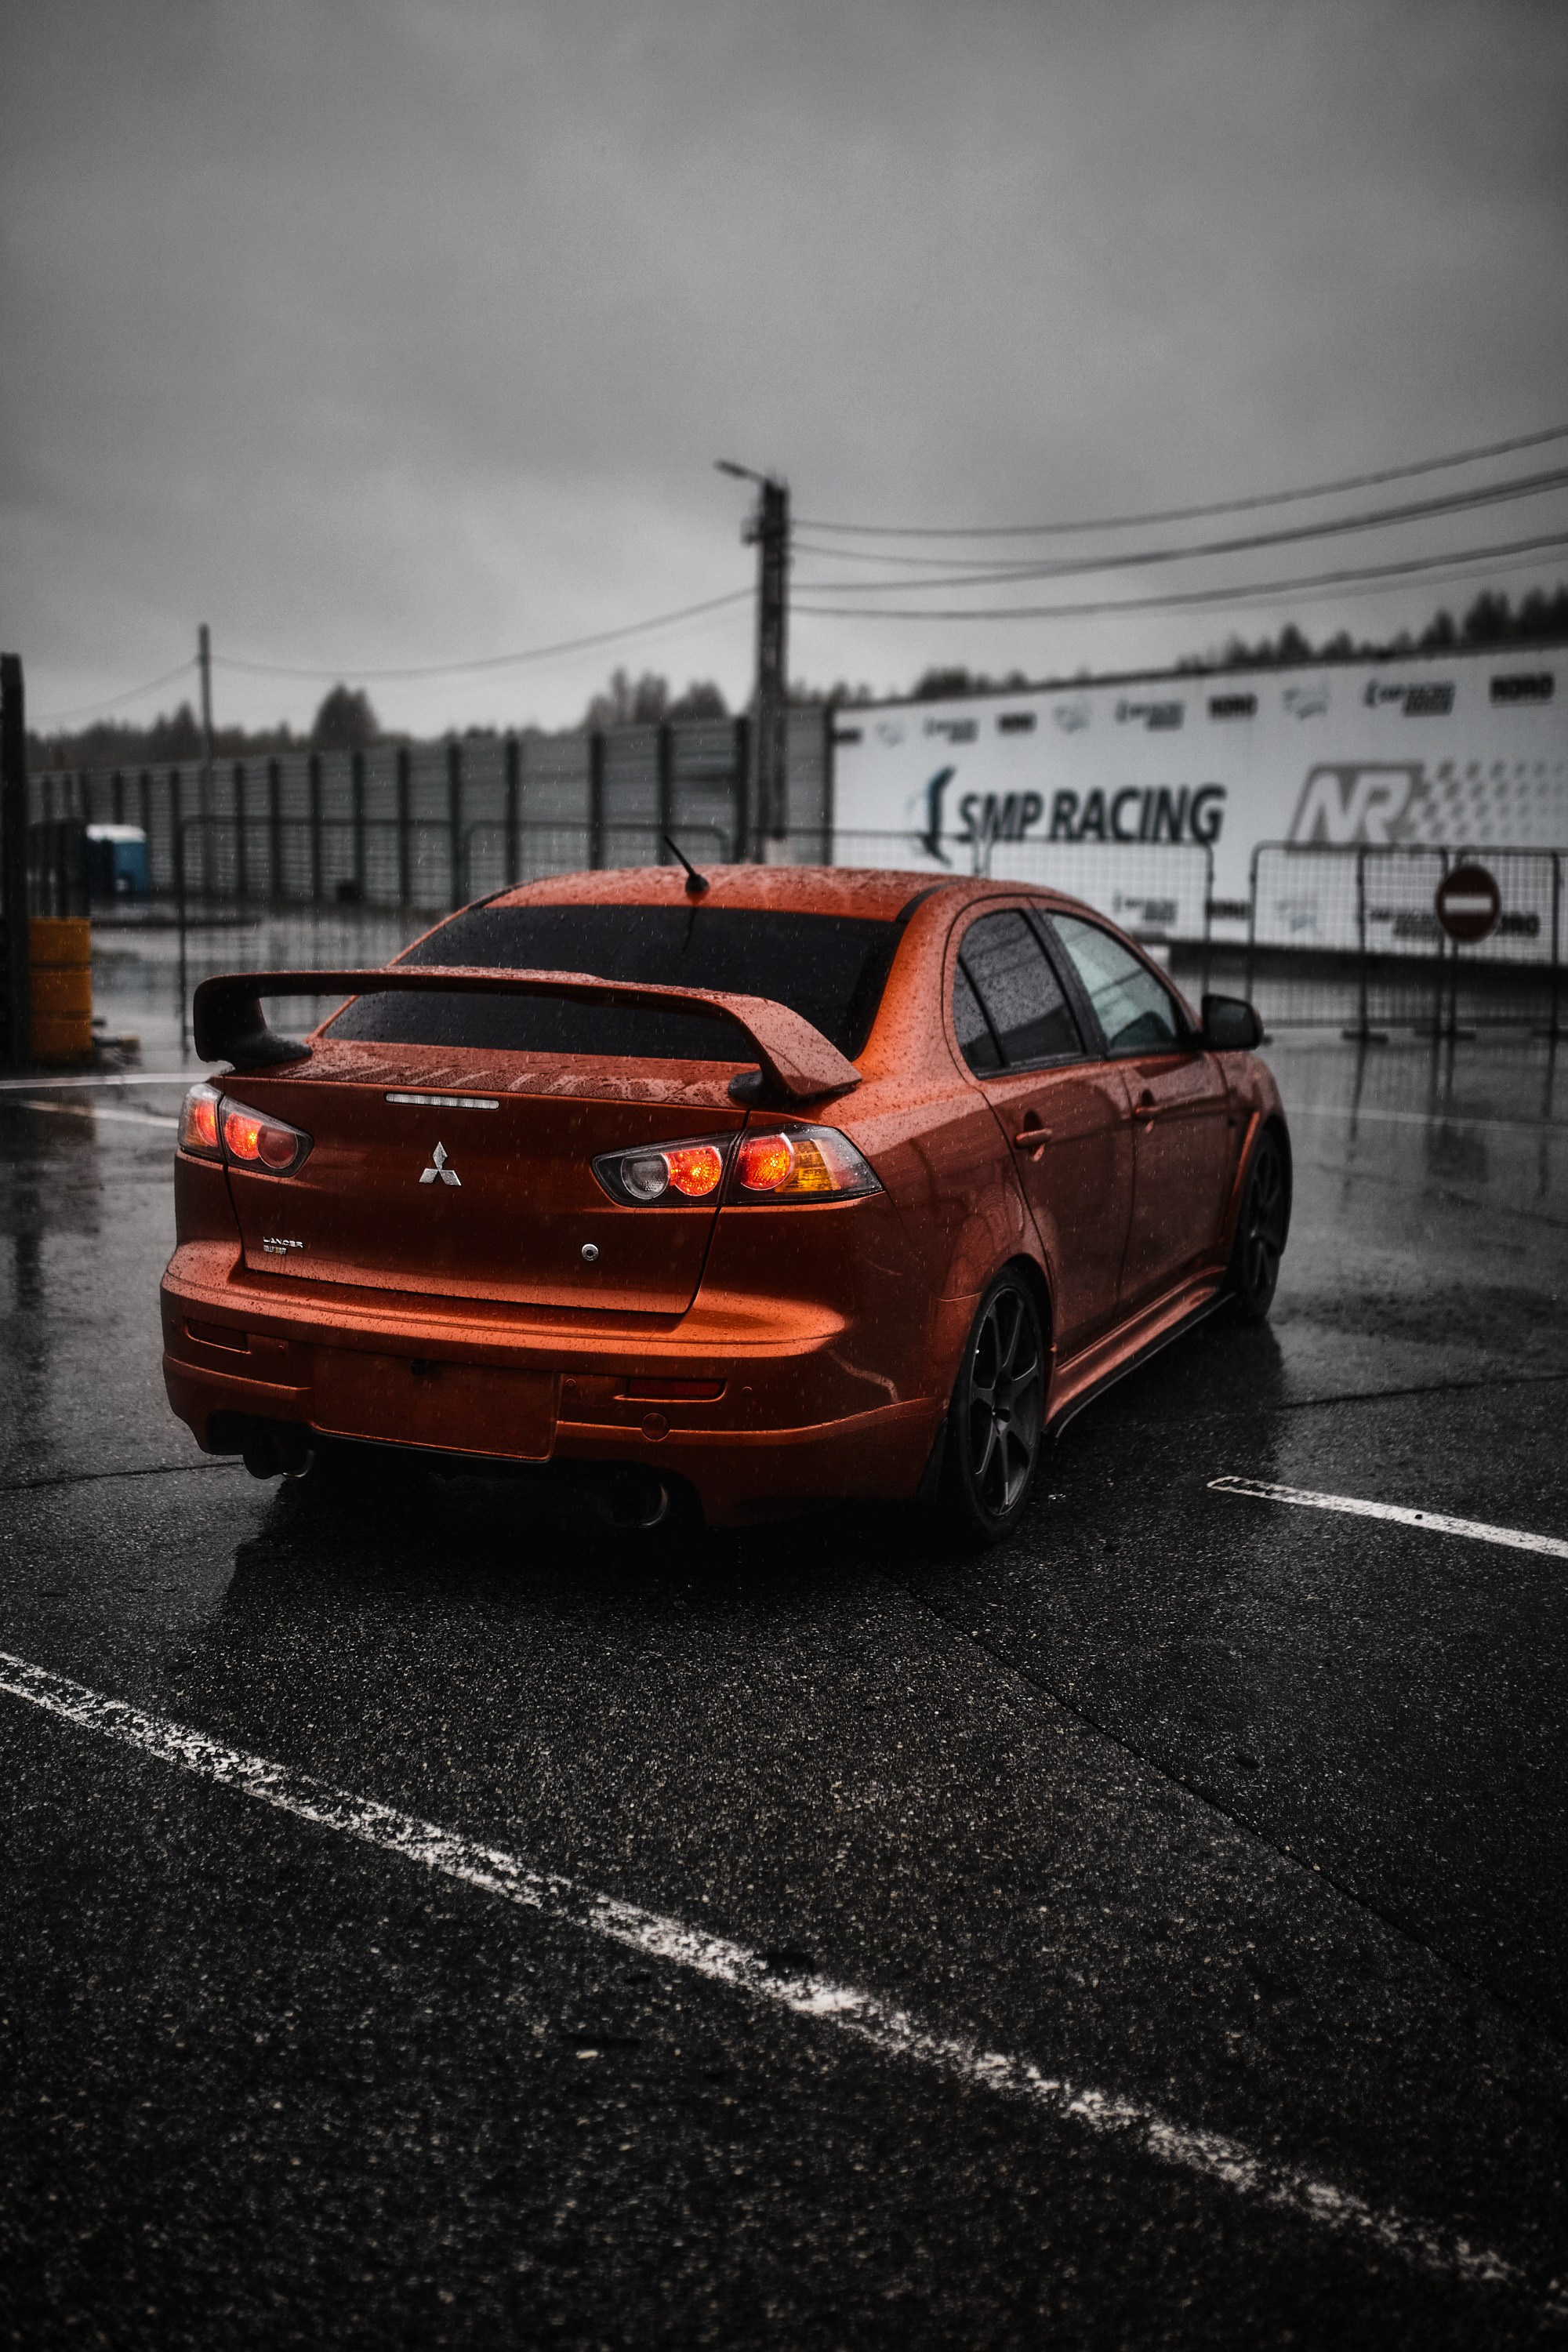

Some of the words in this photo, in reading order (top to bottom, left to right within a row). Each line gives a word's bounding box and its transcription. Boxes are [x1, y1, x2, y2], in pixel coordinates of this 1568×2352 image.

[956, 790, 1044, 842] SMP
[1047, 782, 1227, 844] RACING
[1288, 764, 1414, 848] NR
[263, 1236, 303, 1248] LANCER
